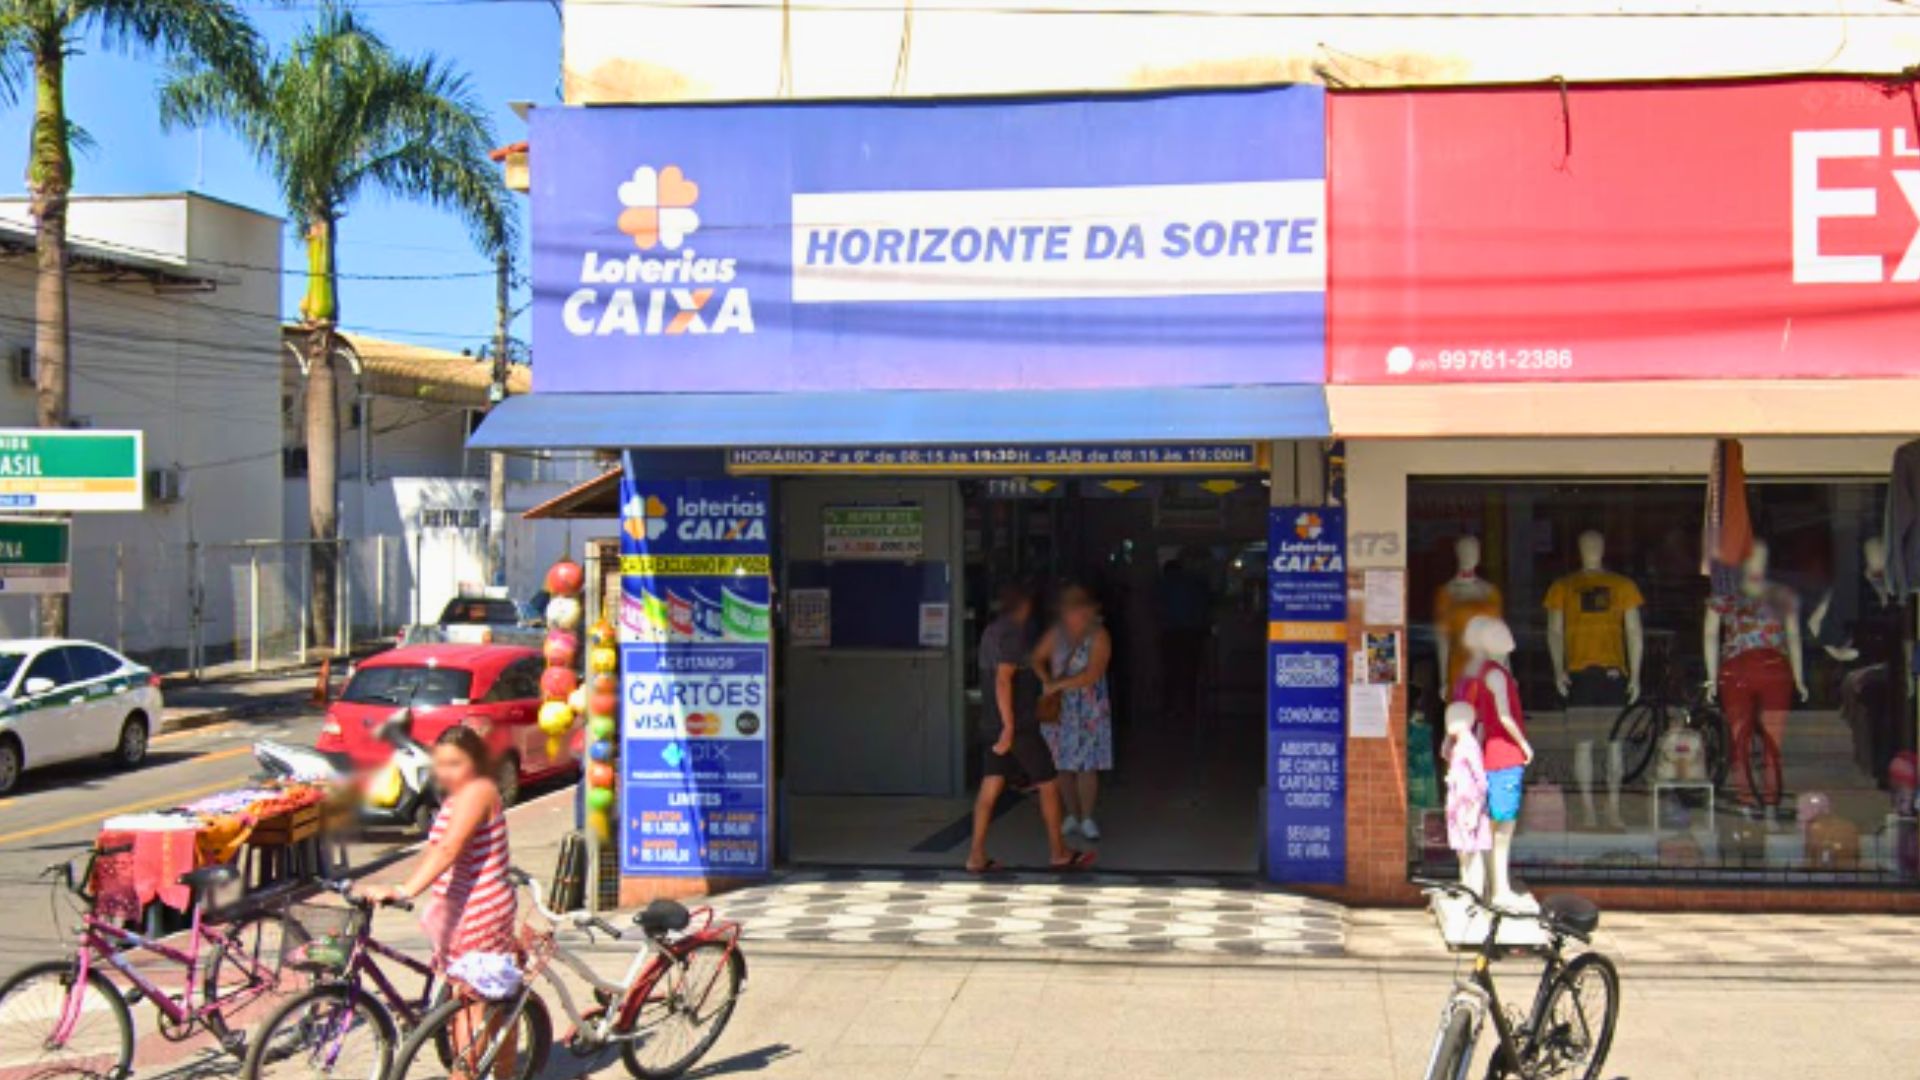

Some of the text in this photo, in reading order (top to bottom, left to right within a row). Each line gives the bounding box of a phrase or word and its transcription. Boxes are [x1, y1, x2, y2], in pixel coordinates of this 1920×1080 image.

[805, 218, 1317, 266] HORIZONTE DA SORTE
[580, 249, 737, 284] Loterias
[562, 287, 755, 337] CAIXA
[735, 447, 815, 464] HORÁRIO
[874, 450, 896, 464] de
[1087, 449, 1109, 463] de
[676, 494, 766, 517] loterias
[676, 519, 767, 541] CAIXA
[1280, 541, 1337, 553] Loterias
[1272, 555, 1344, 573] CAIXA
[630, 674, 760, 705] CARTÕES
[635, 715, 675, 729] VISA
[1287, 842, 1302, 859] DE
